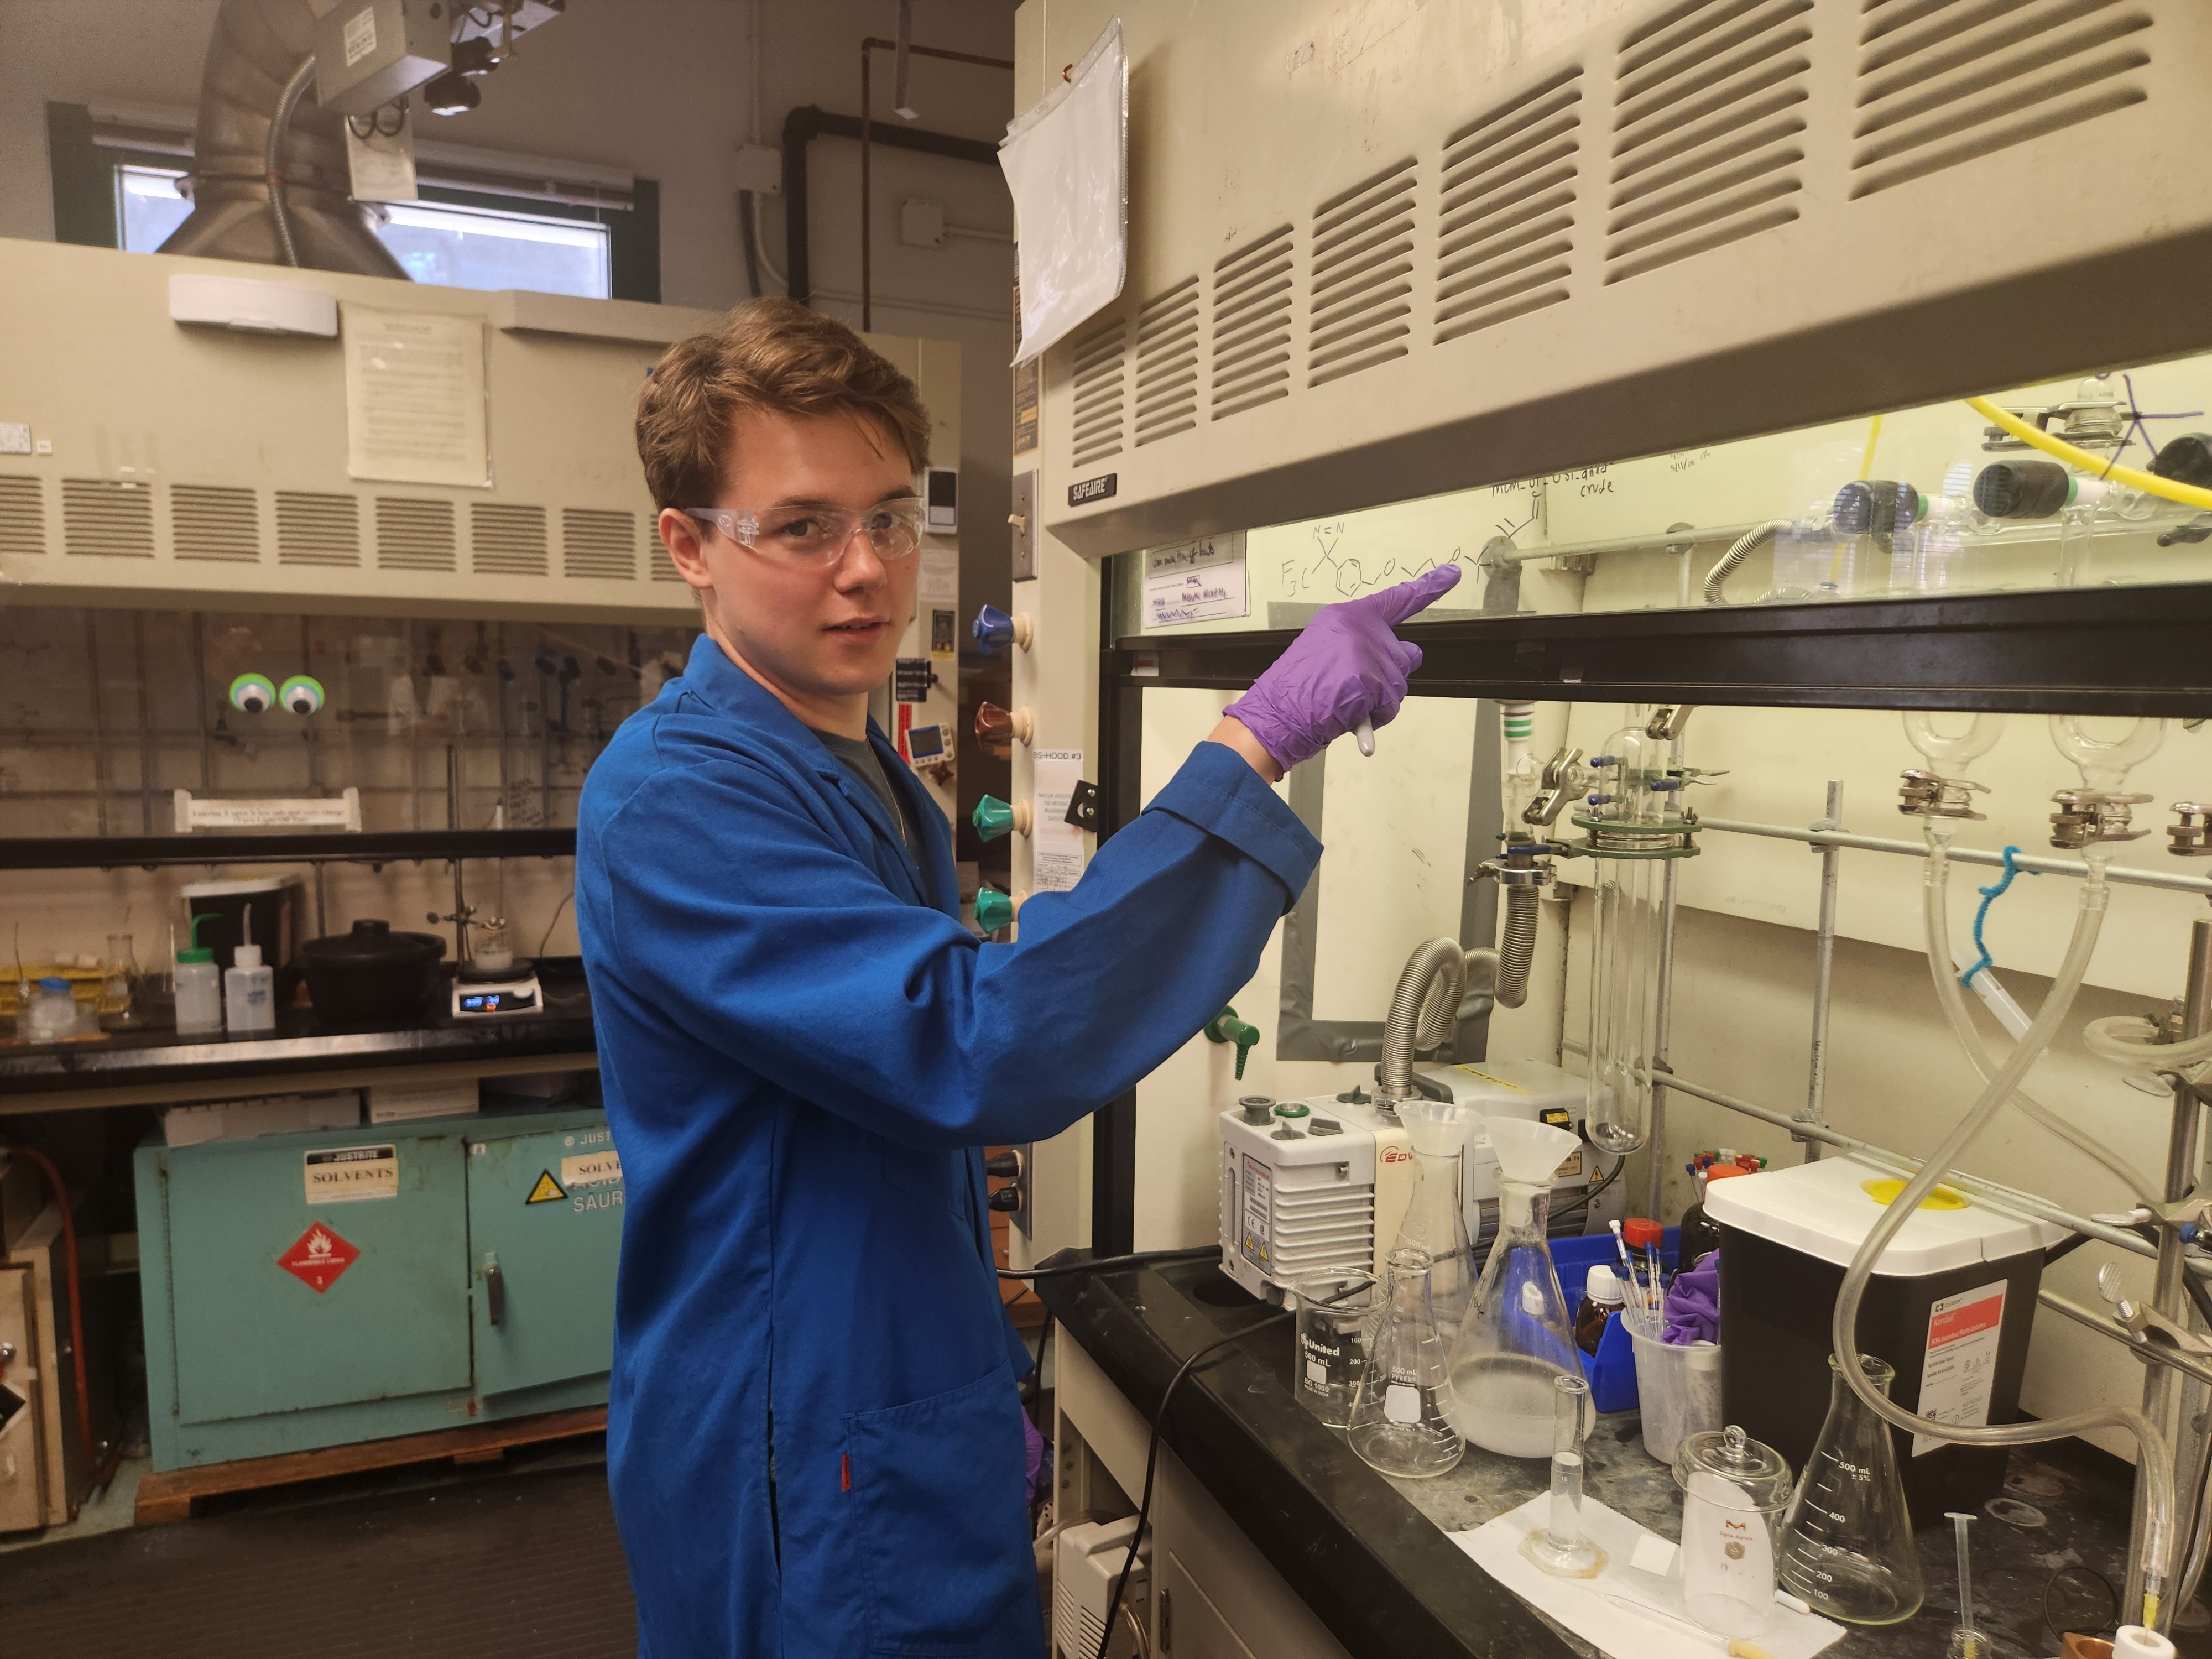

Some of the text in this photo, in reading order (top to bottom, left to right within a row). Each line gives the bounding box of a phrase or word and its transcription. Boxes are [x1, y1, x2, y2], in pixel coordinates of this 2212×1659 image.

[313, 1168, 393, 1184] SOLVENTS
[316, 1276, 323, 1285] 3
[1309, 1339, 1340, 1357] United
[1305, 1350, 1331, 1368] 500 mL
[1392, 1366, 1405, 1374] 500
[1305, 1377, 1329, 1393] BG 1000
[1839, 1462, 1870, 1475] 500 mL
[1829, 1511, 1845, 1523] 400
[1822, 1544, 1838, 1556] 300
[1816, 1571, 1832, 1583] 200
[1813, 1589, 1828, 1600] 100
